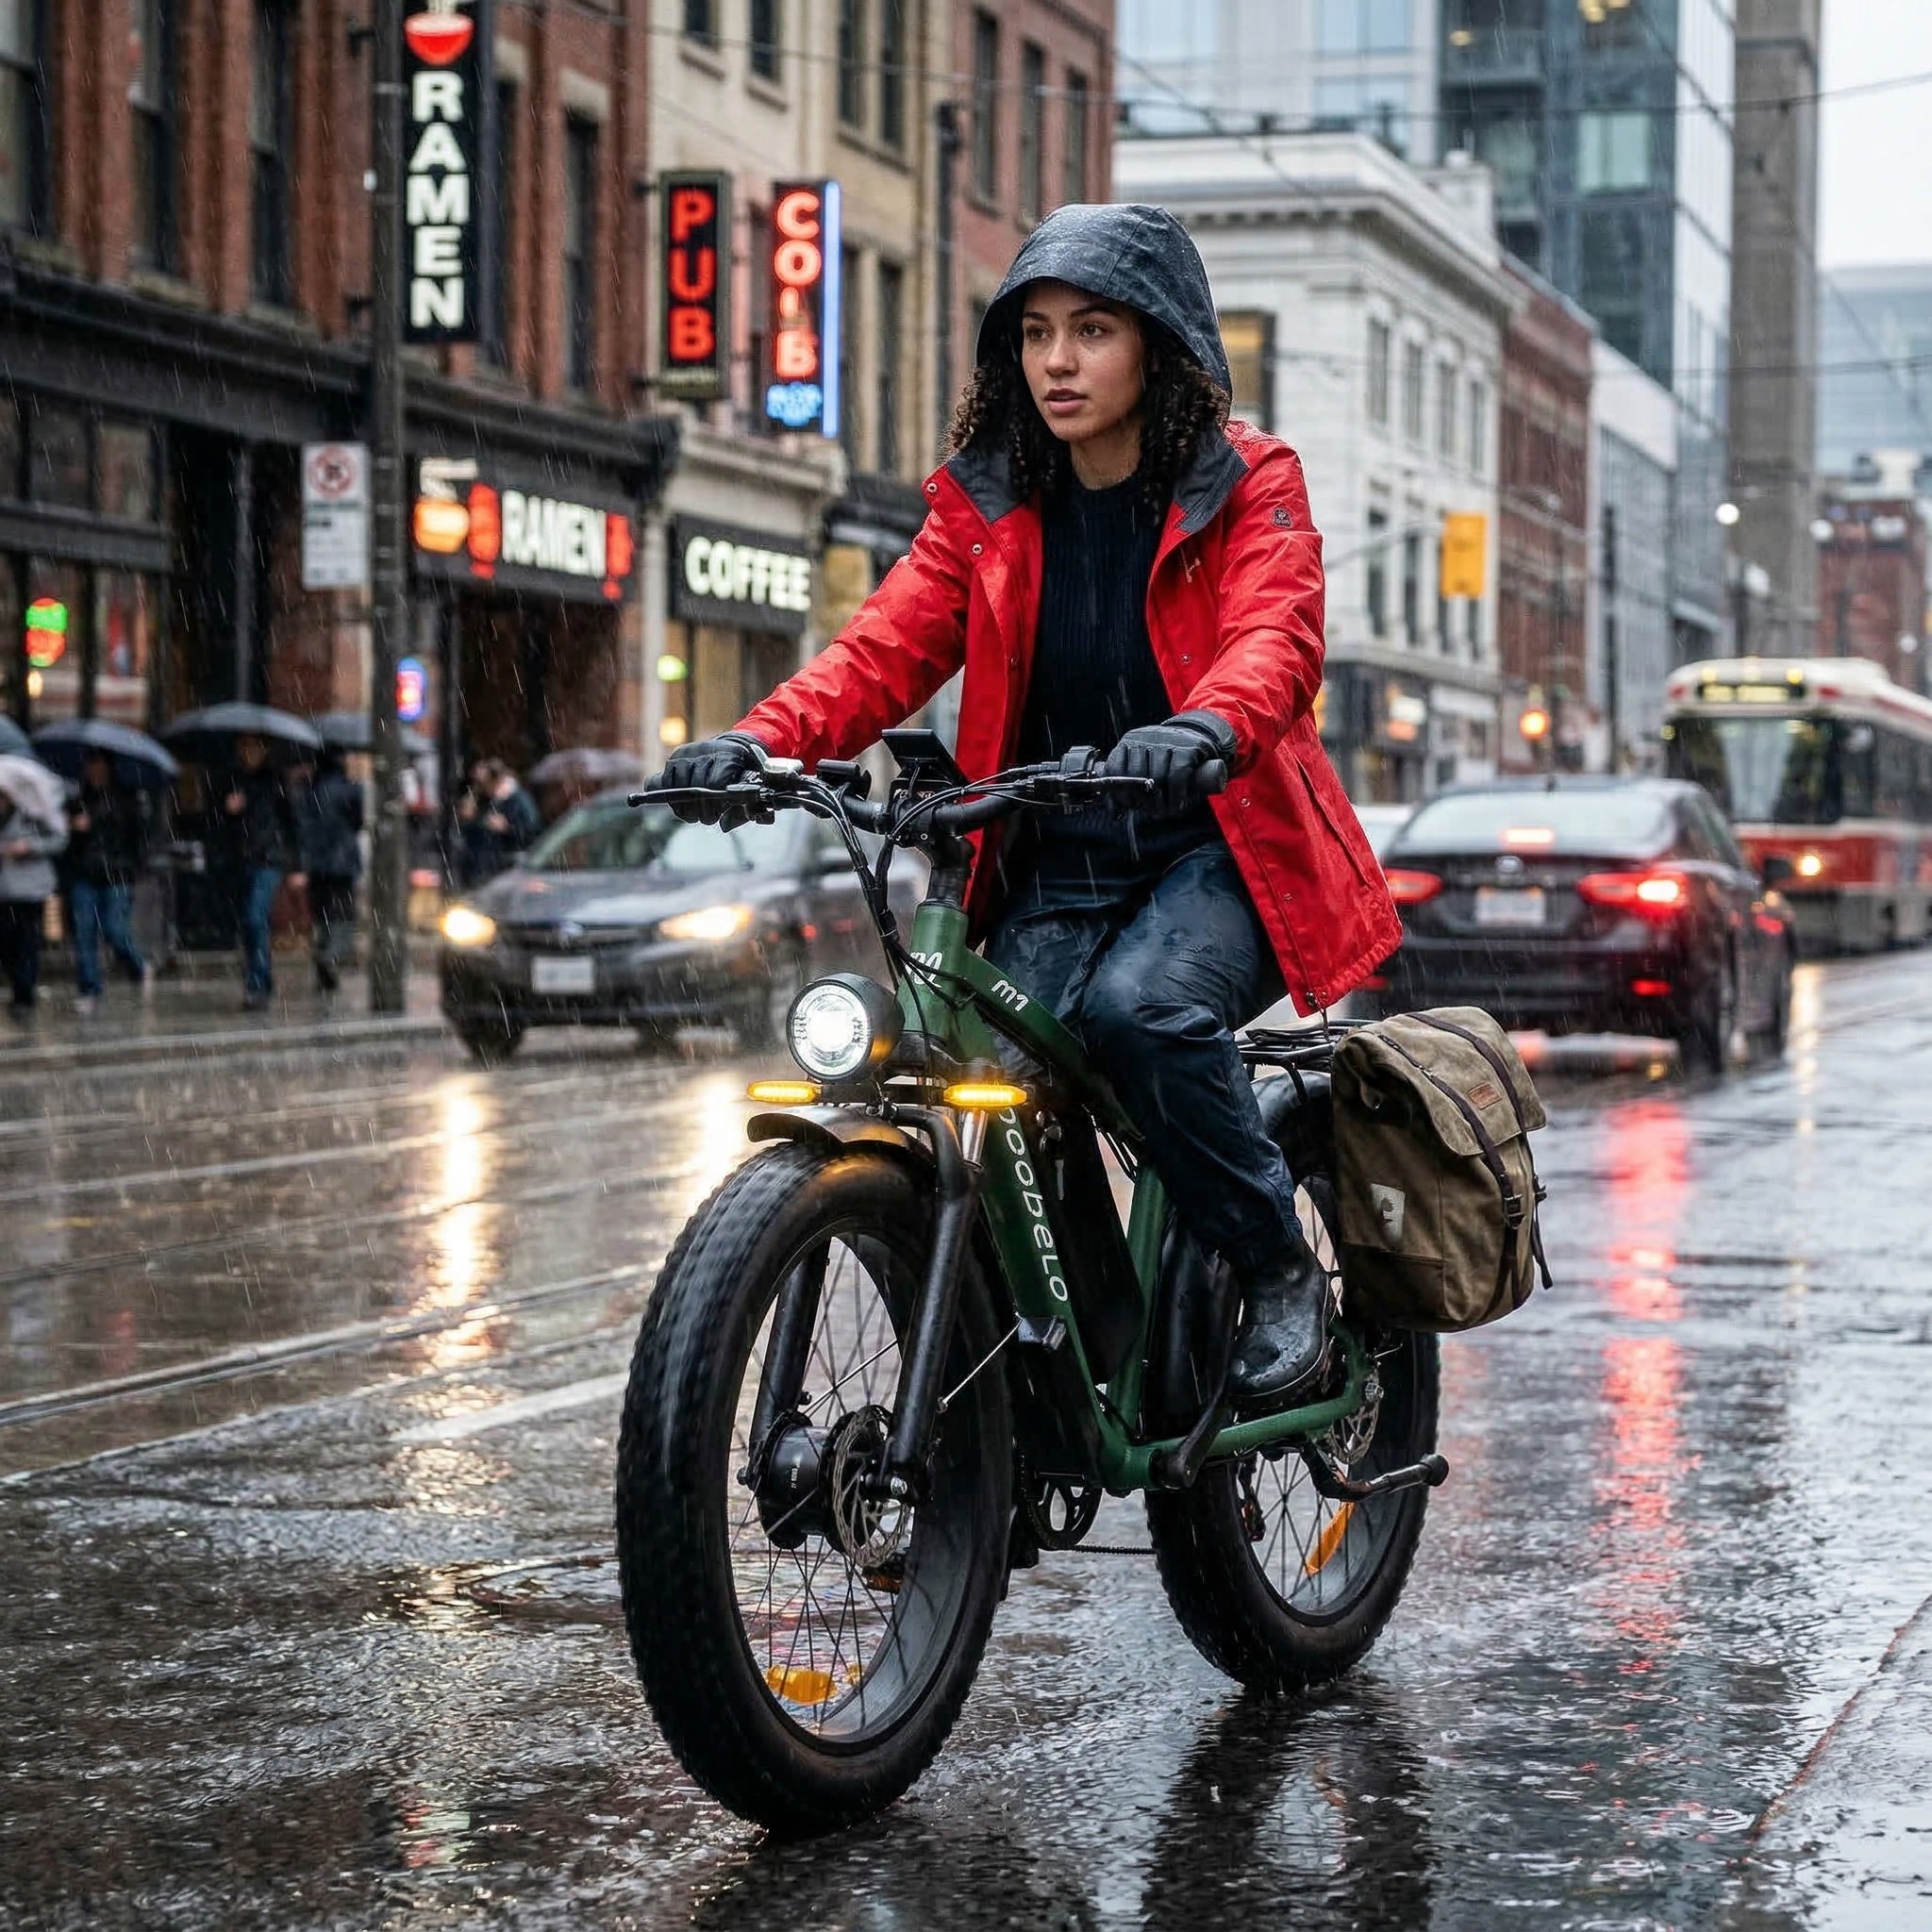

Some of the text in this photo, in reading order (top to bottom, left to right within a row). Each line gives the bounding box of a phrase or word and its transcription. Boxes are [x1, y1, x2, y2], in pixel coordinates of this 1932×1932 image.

[407, 70, 470, 329] RAMEN
[669, 189, 716, 361] PUB
[686, 536, 811, 611] COFFEE
